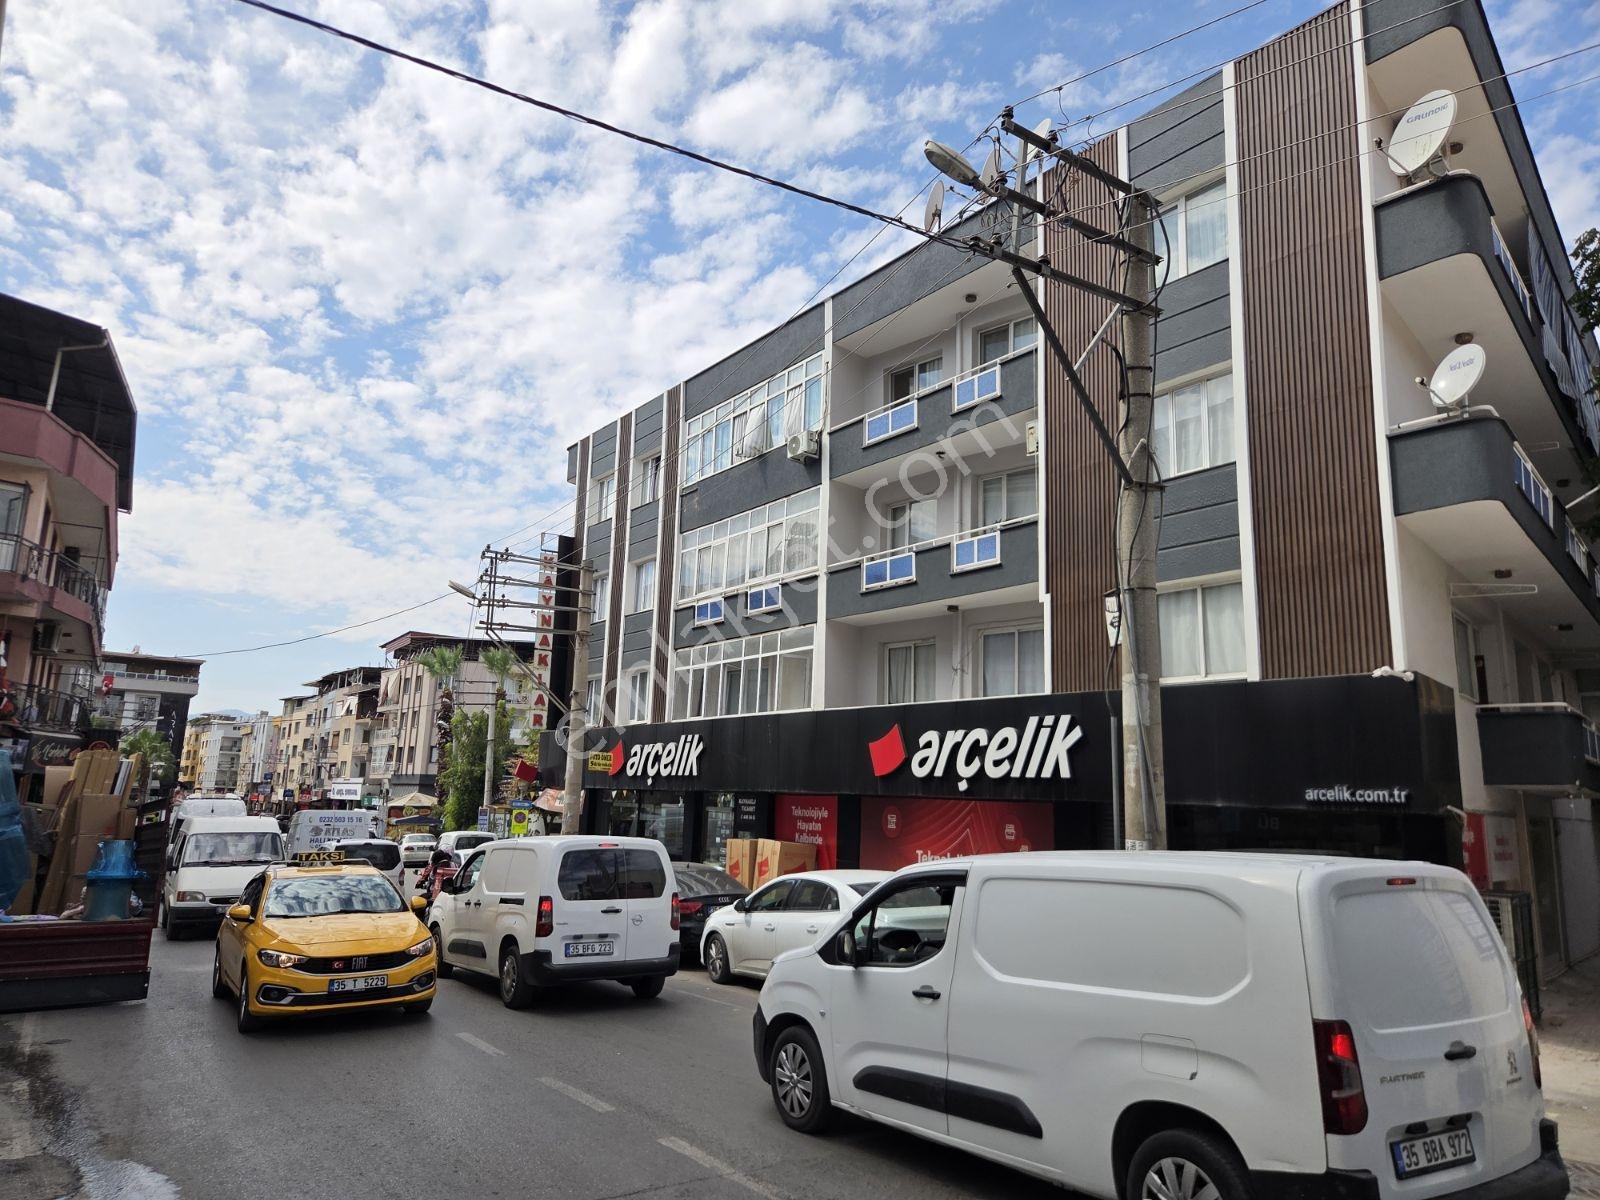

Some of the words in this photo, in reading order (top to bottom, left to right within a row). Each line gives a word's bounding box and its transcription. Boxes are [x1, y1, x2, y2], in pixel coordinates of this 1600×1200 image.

[1406, 102, 1449, 124] GRUNDIG
[532, 556, 555, 727] KAYNAKLAR
[626, 734, 704, 785] arçelik
[911, 714, 1083, 792] arçelik
[1305, 784, 1409, 804] arcelik.com.tr
[791, 806, 829, 820] Teknolojiyle
[570, 944, 580, 954] 35
[582, 944, 596, 953] BFG
[598, 943, 612, 952] 223
[352, 957, 369, 970] FIAT
[334, 980, 346, 990] 35
[352, 979, 358, 989] T
[364, 977, 386, 988] 5229
[1402, 1145, 1420, 1169] 35
[1423, 1135, 1447, 1165] BBA
[1447, 1131, 1472, 1158] 972
